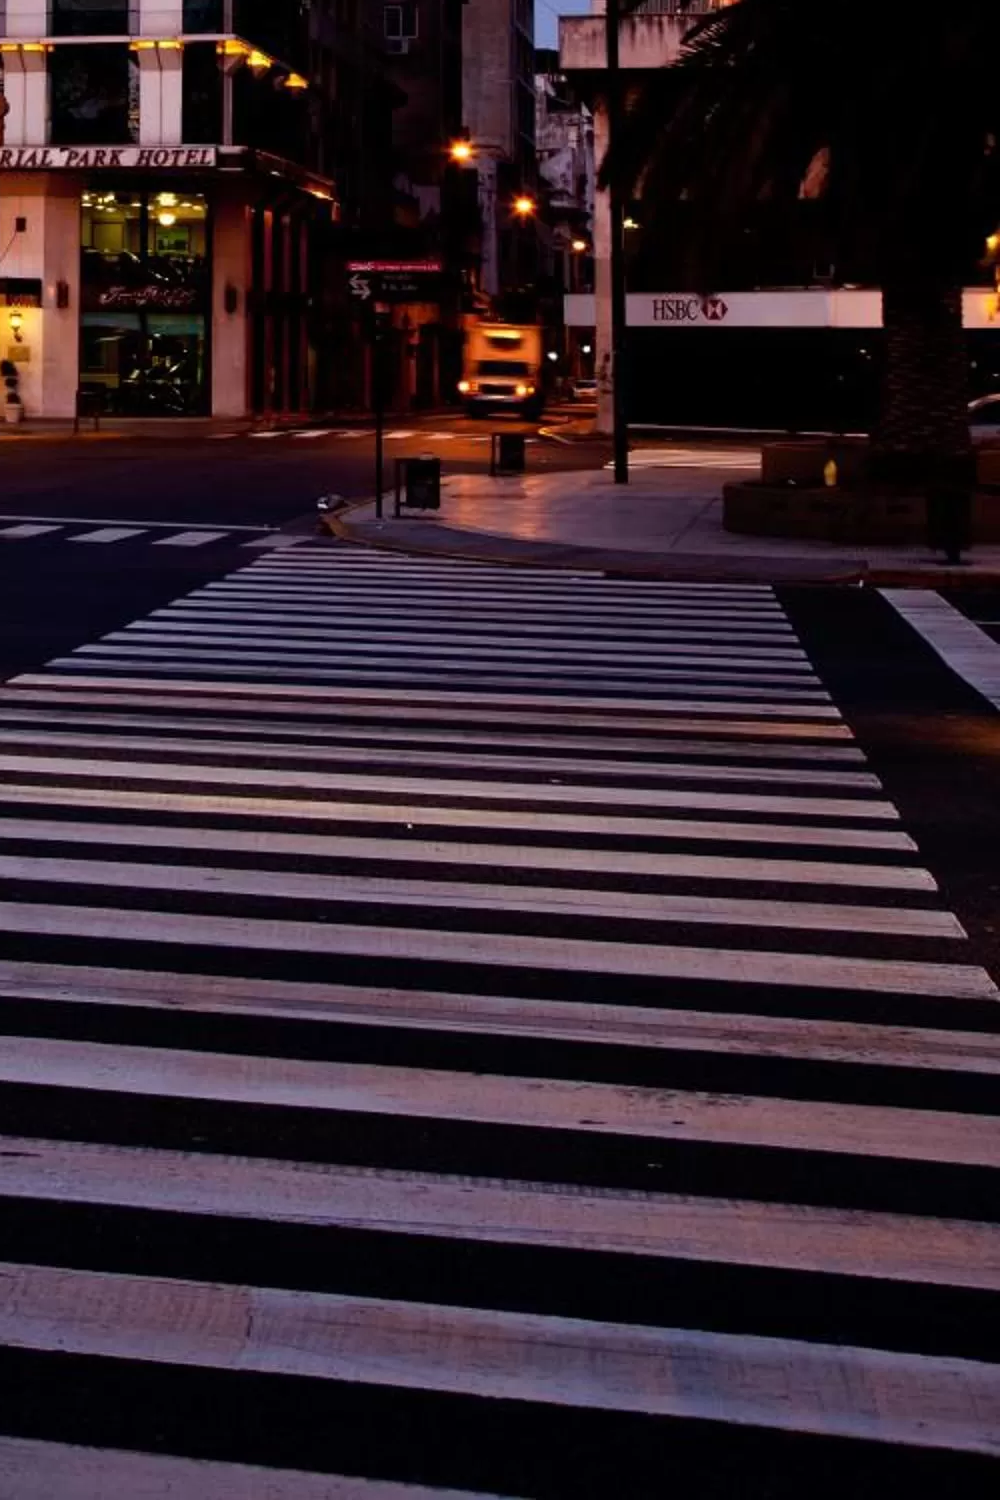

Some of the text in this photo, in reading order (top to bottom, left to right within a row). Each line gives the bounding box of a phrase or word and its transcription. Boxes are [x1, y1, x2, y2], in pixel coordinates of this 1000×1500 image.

[59, 147, 125, 167] PARK
[135, 148, 213, 166] HOTEL
[652, 299, 699, 321] HSBC
